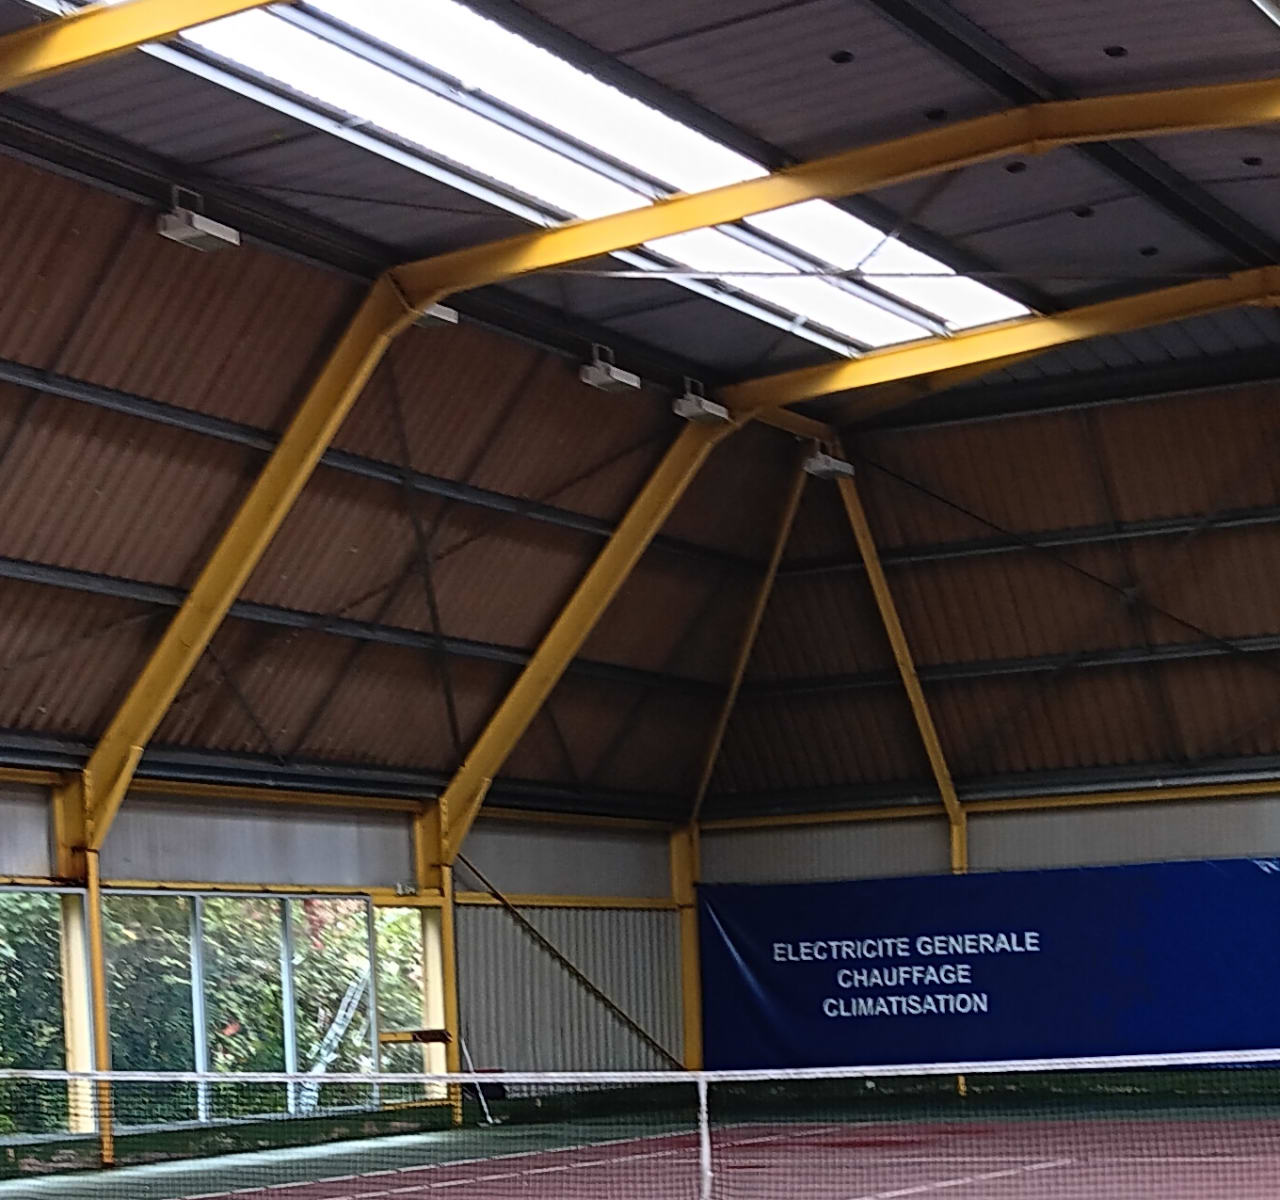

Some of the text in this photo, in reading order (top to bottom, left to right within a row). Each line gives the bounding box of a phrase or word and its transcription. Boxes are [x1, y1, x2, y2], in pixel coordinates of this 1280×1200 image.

[773, 932, 1041, 962] ELECTRICITE GENERALE
[837, 964, 972, 989] CHAUFFAGE
[823, 992, 989, 1018] CLIMATISATION
